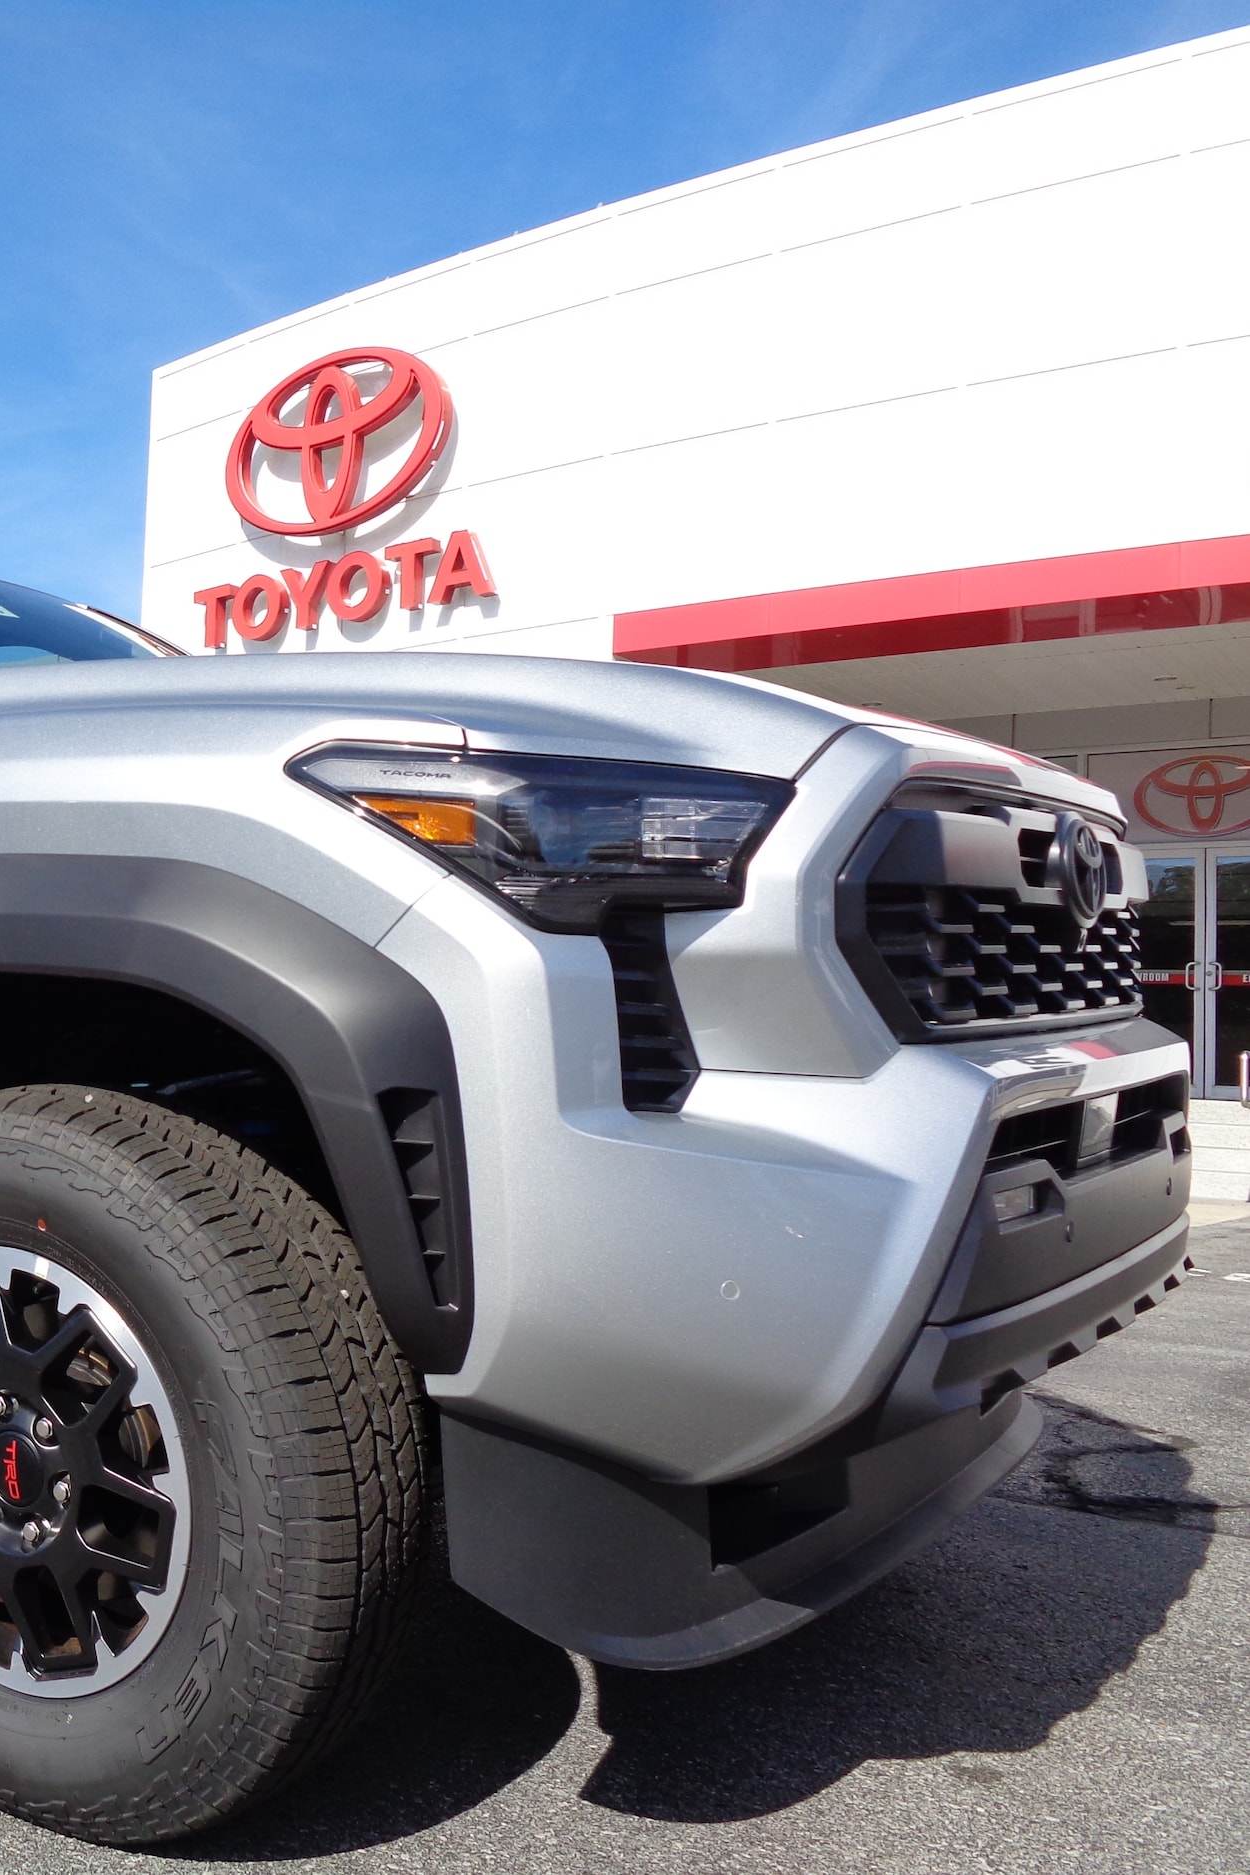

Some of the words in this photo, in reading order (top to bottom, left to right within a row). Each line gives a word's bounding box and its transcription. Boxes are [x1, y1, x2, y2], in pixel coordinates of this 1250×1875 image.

[194, 529, 497, 649] TOYOTA
[379, 769, 452, 779] TACOMA
[2, 1439, 21, 1500] TRD
[135, 1399, 245, 1765] FALKEN
